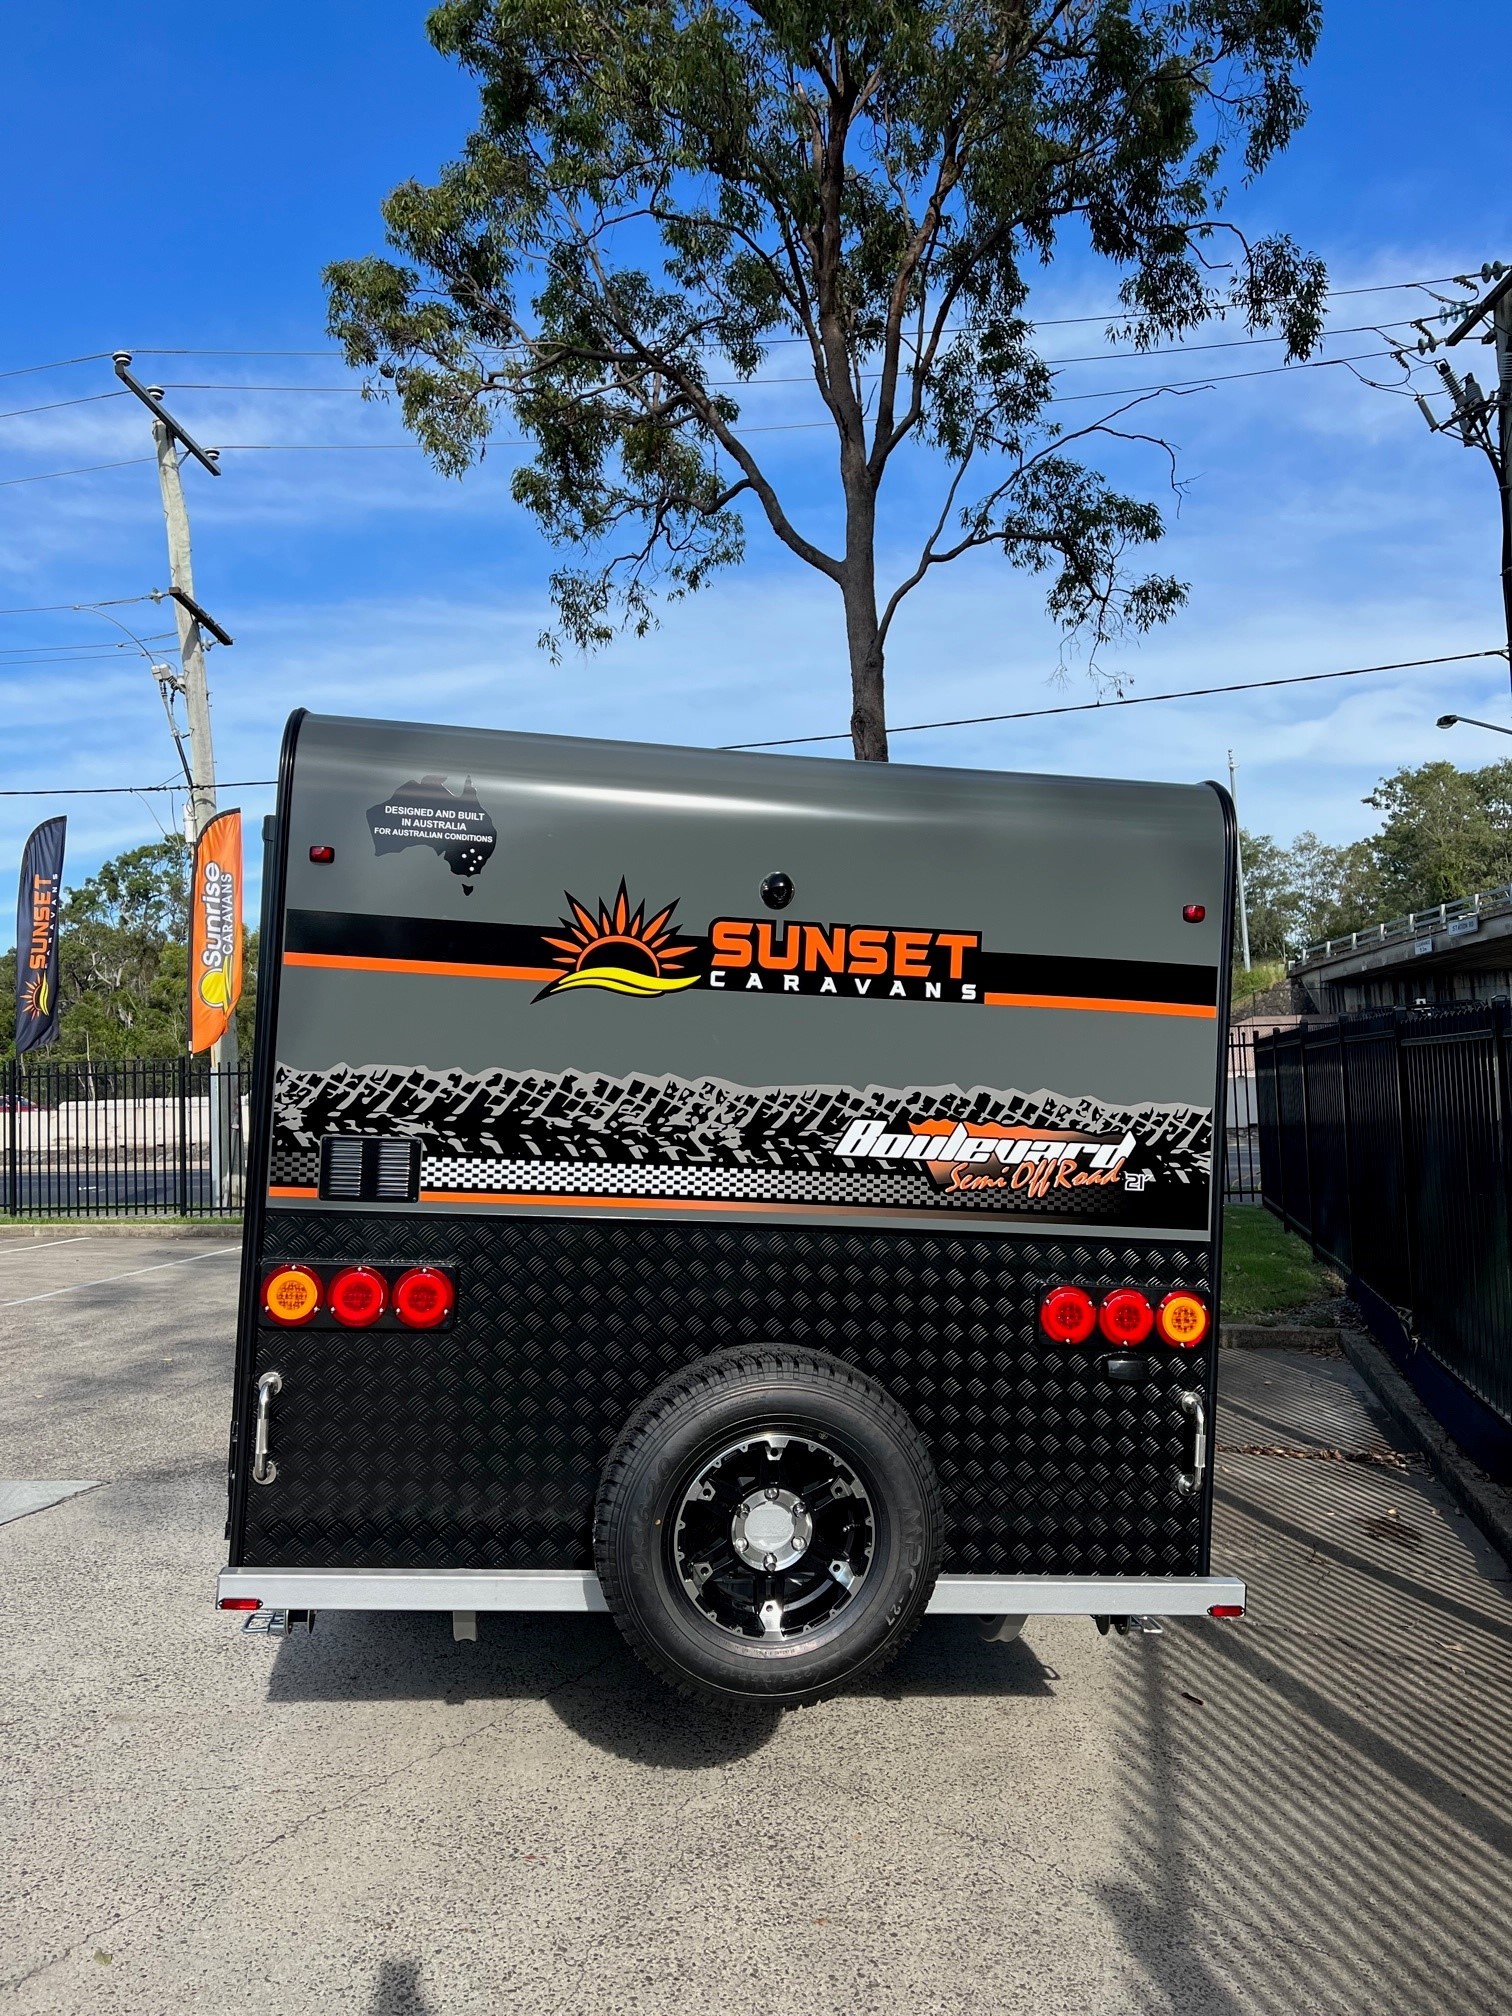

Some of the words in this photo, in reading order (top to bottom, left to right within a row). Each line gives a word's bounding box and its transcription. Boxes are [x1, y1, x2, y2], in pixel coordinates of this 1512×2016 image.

[374, 827, 392, 836] FOR
[392, 828, 443, 840] AUSTRALIAN
[444, 833, 493, 843] CONDITIONS
[385, 805, 434, 817] DESIGNED
[435, 810, 456, 819] AND
[458, 811, 485, 821] BUILT
[401, 818, 411, 827] IN
[412, 819, 467, 831] AUSTRALIA
[29, 874, 52, 970] SUNSET
[202, 862, 221, 967] Sunrise
[221, 873, 234, 956] CARAVANS
[710, 920, 978, 979] SUNSET
[709, 970, 977, 1000] CARAVANS
[833, 1119, 1137, 1169] Boulevard
[945, 1162, 1007, 1194] Semi
[1011, 1158, 1055, 1198] Off
[1054, 1157, 1126, 1188] Road
